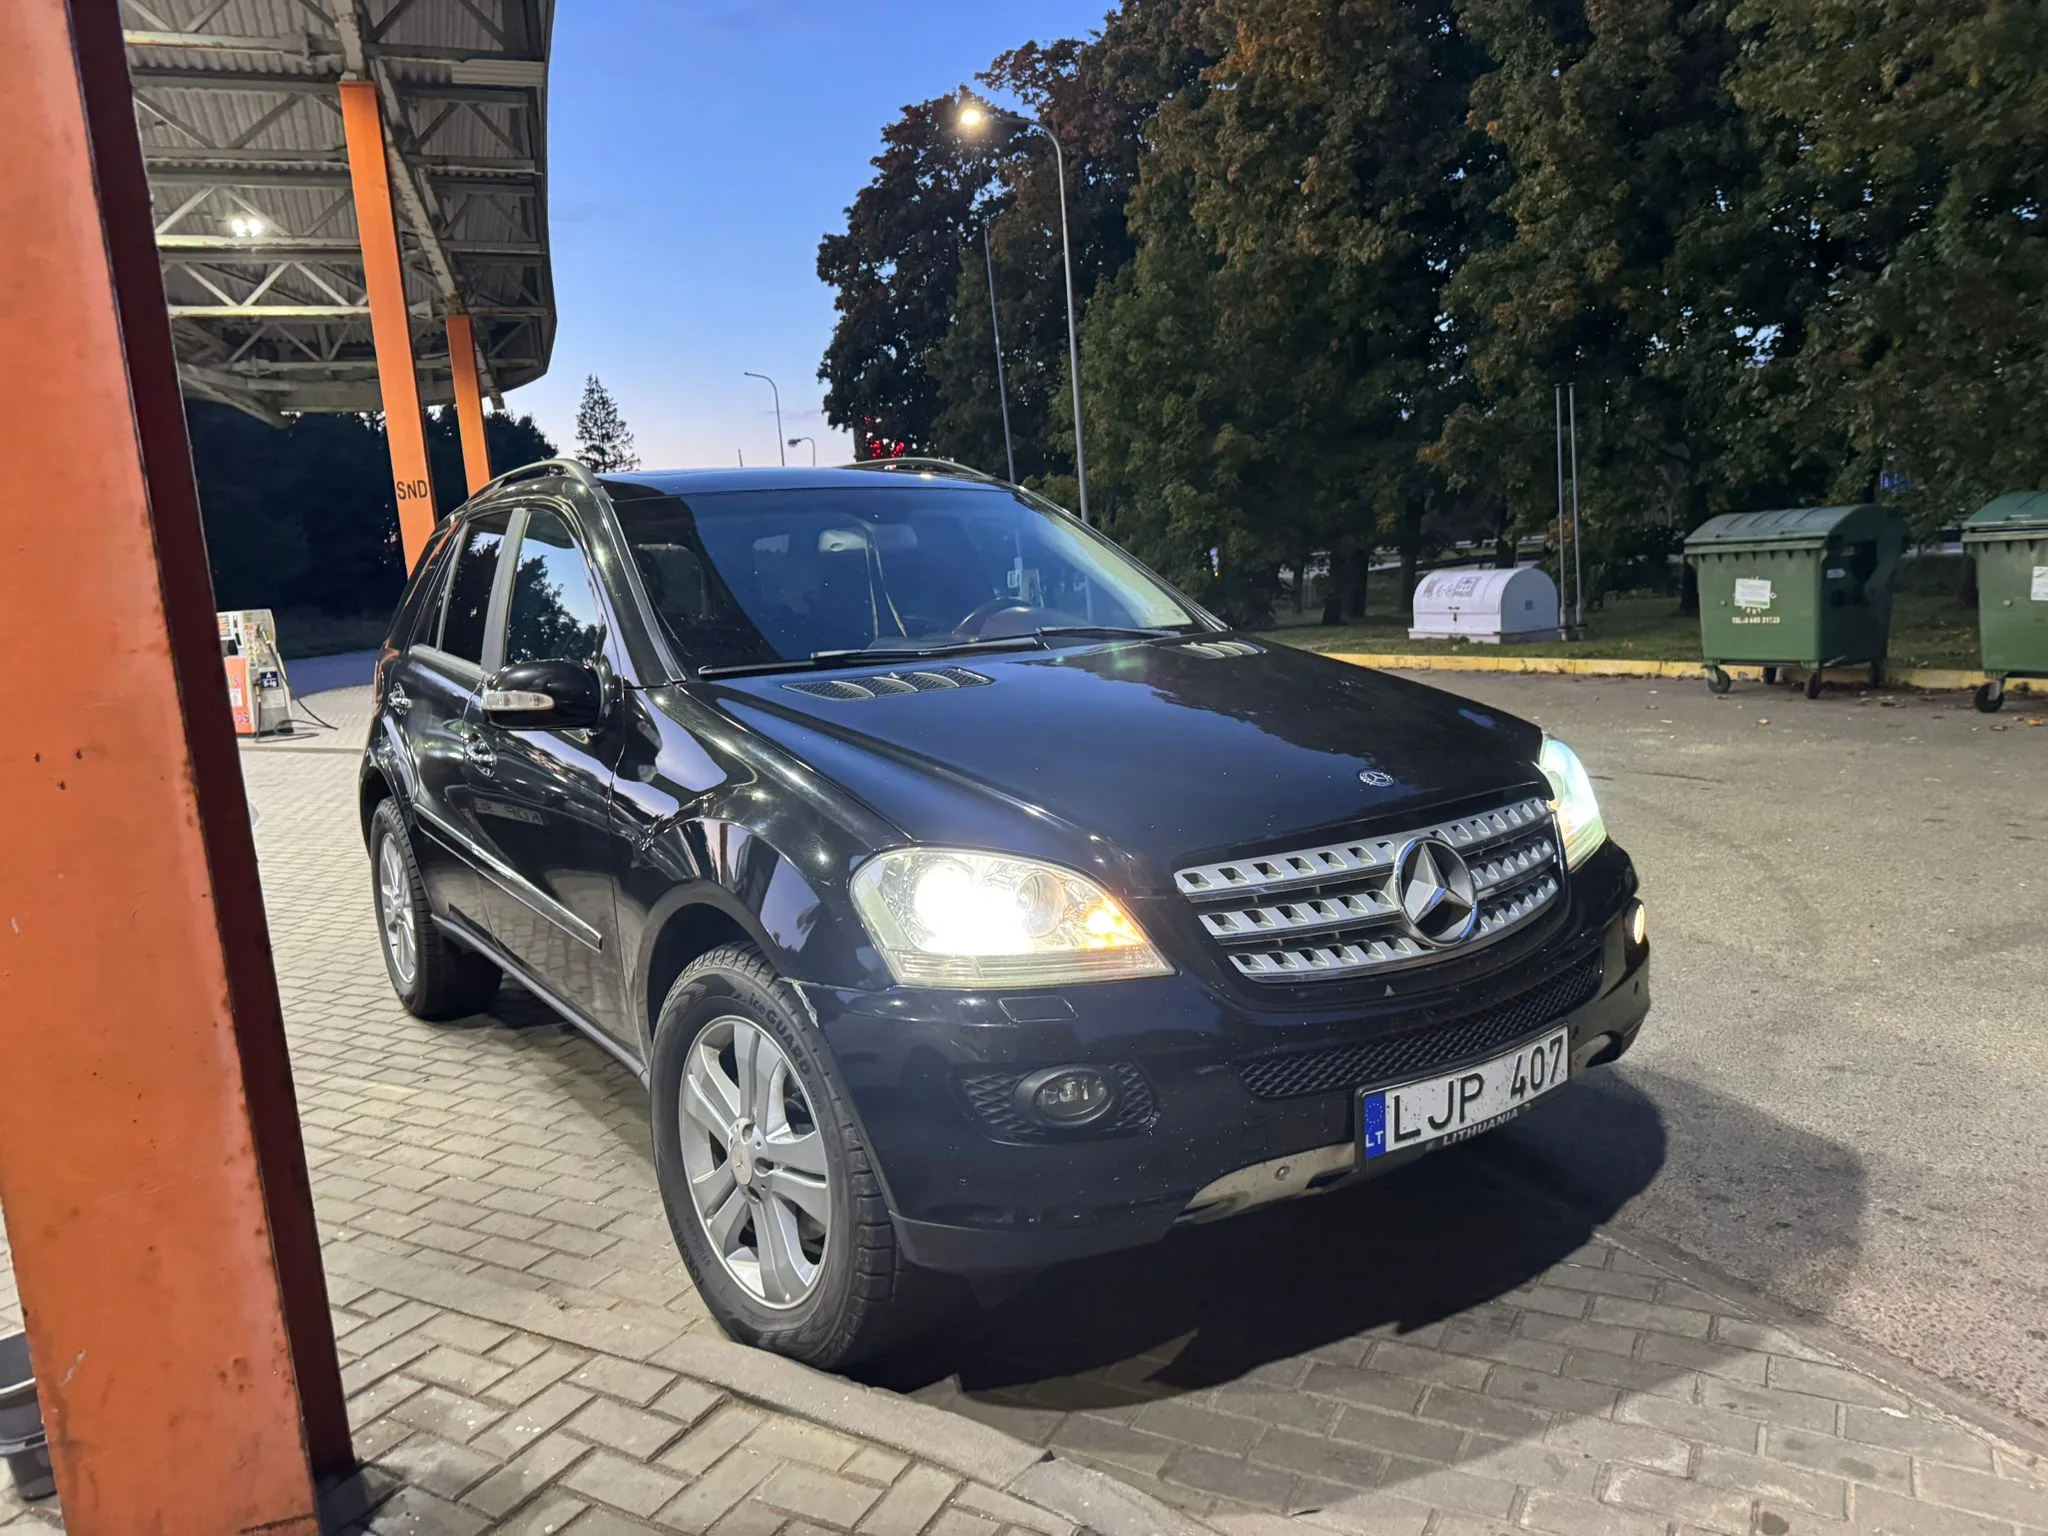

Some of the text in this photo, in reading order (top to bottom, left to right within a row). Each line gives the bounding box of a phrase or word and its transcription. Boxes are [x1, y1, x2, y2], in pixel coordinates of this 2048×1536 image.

[396, 480, 428, 500] SND
[748, 992, 811, 1076] iceGUARD
[1393, 1033, 1564, 1143] LJP 407
[1366, 1130, 1385, 1148] LT
[1443, 1108, 1519, 1146] LITHUANIA
